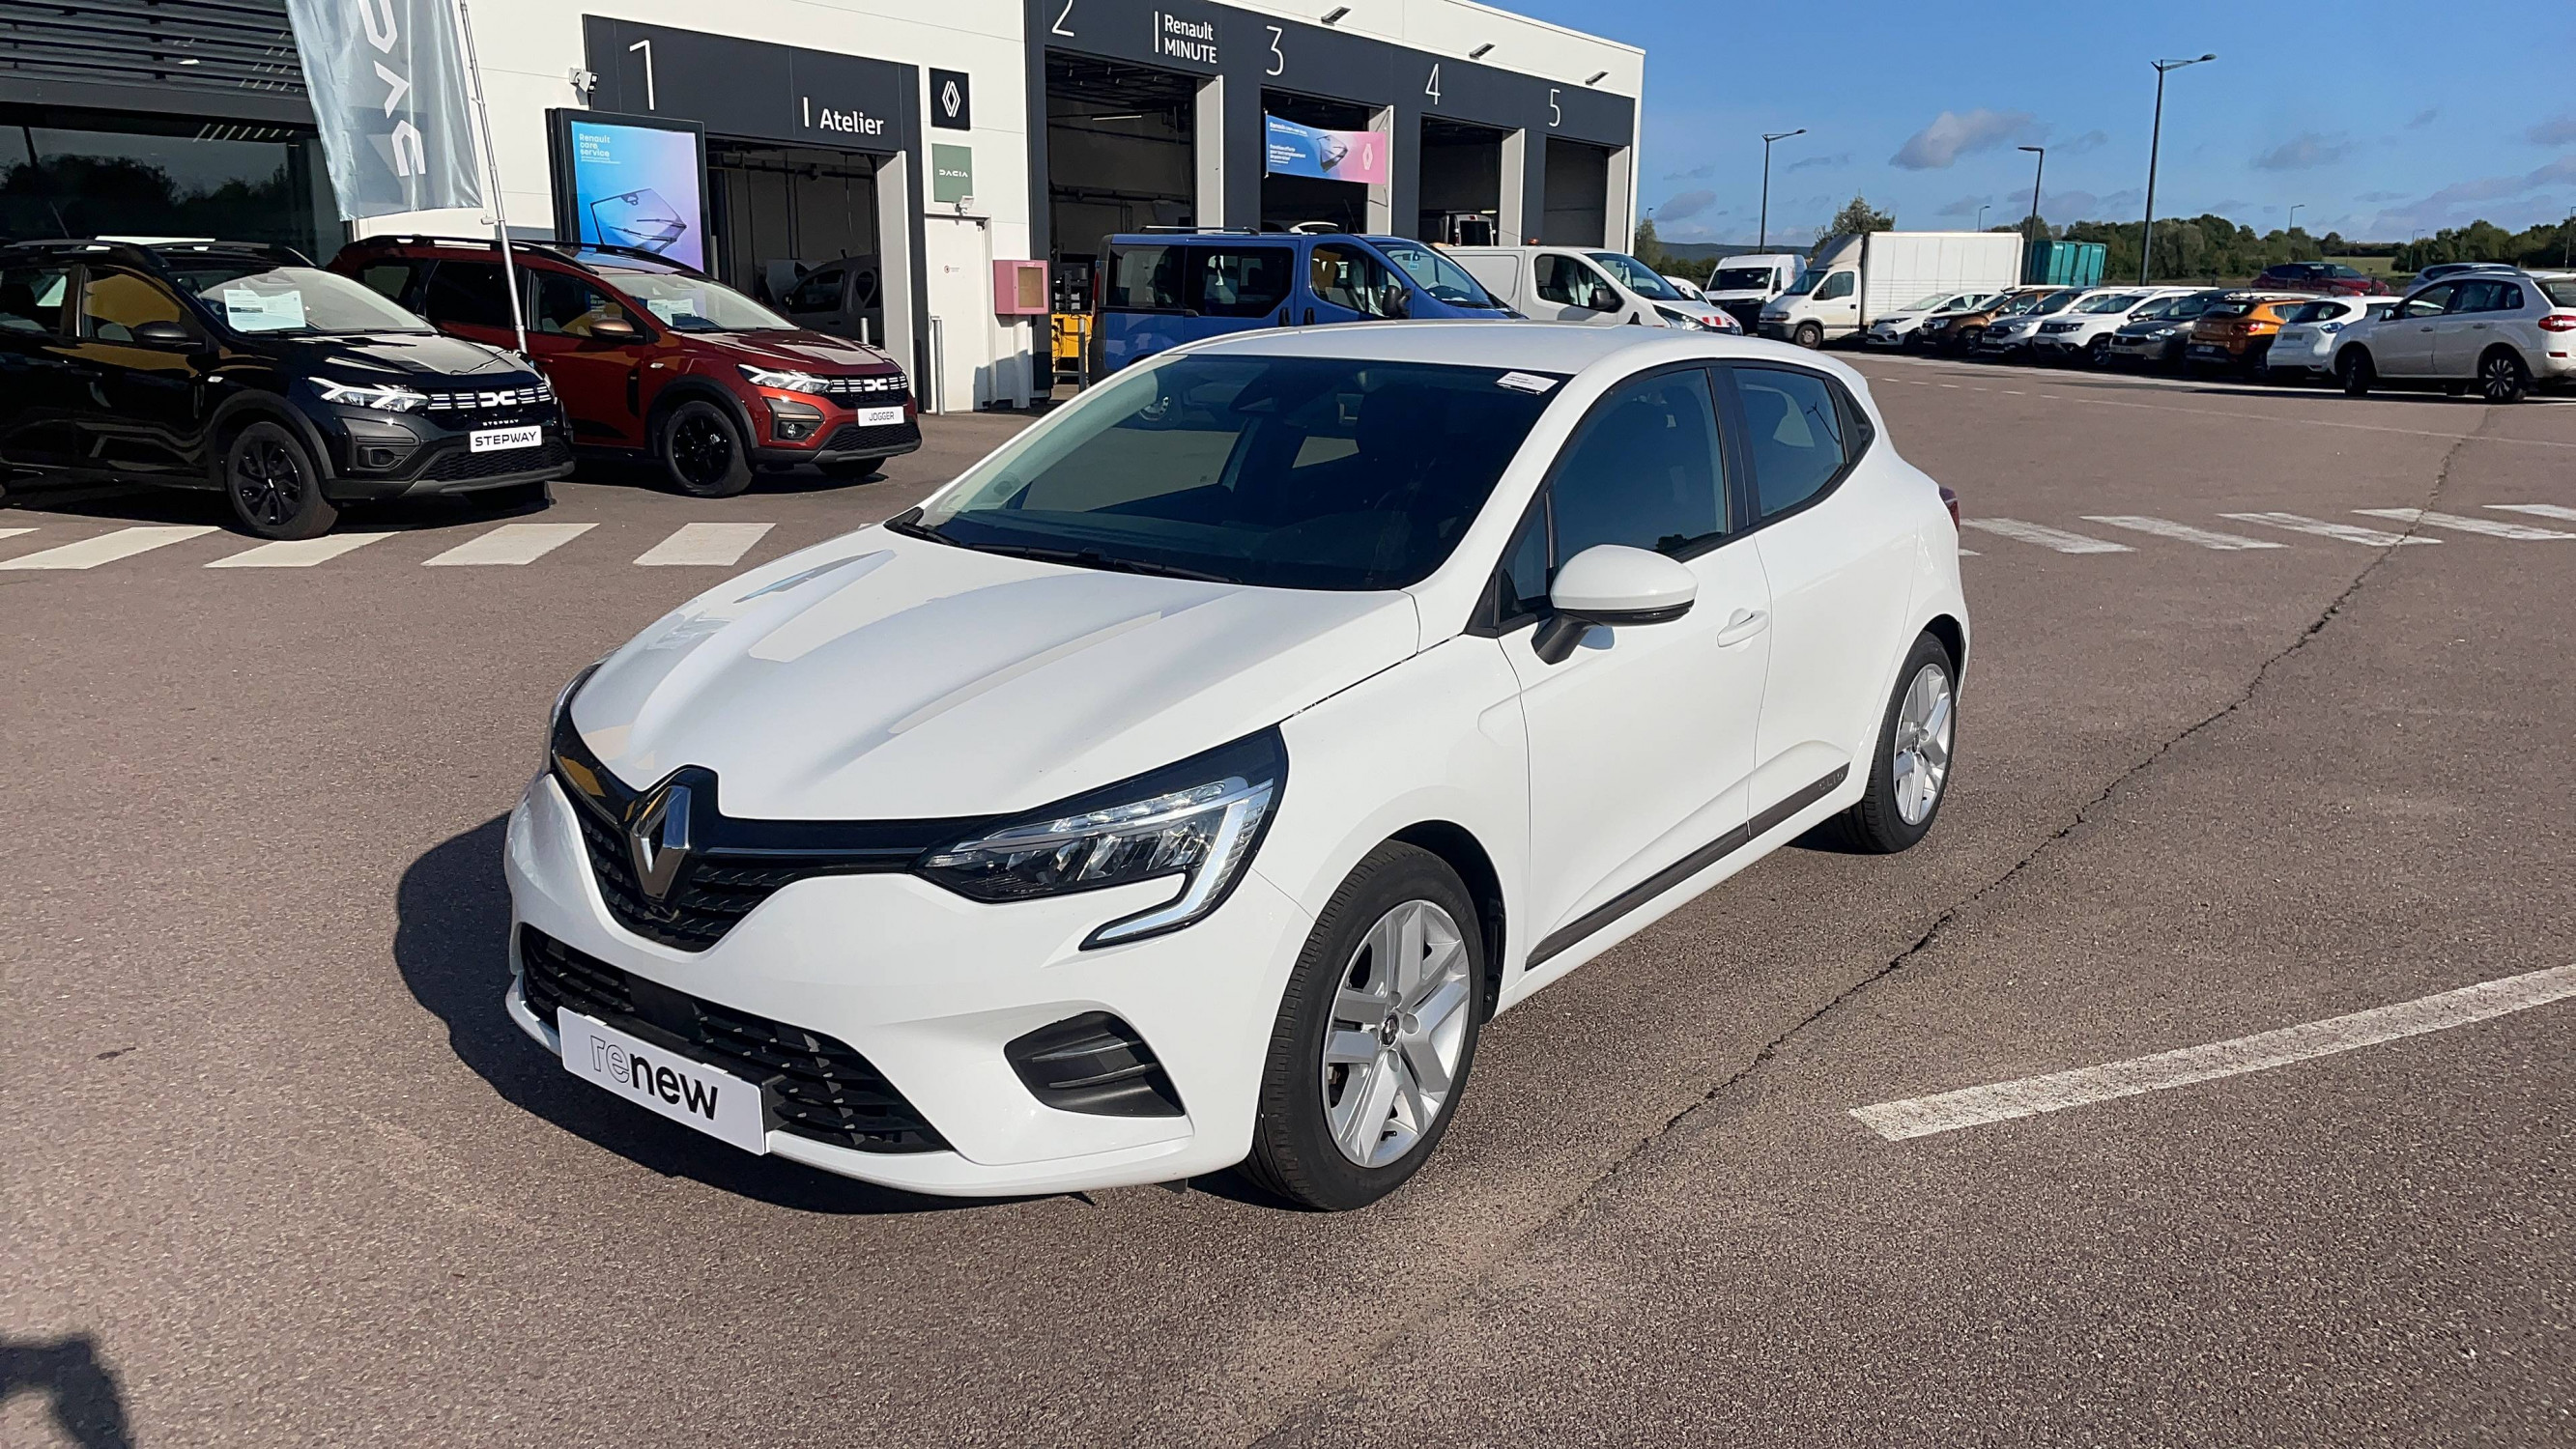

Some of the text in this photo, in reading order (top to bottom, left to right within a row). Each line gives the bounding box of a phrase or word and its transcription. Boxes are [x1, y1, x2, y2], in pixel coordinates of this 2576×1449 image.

[1051, 0, 1075, 37] 2
[1164, 14, 1214, 42] Renault
[1164, 37, 1217, 64] MINUTE
[1266, 25, 1284, 76] 3
[629, 40, 655, 111] 1
[1425, 63, 1441, 105] 4
[819, 107, 884, 135] Atelier
[1548, 88, 1560, 128] 5
[579, 133, 611, 144] Renault
[580, 149, 610, 157] service
[938, 168, 968, 178] DACIA
[482, 418, 520, 427] STEPWAY
[868, 411, 895, 421] JOGGER
[474, 431, 537, 447] STEPWAY
[1818, 772, 1844, 791] CLIO
[590, 1035, 719, 1121] renew
